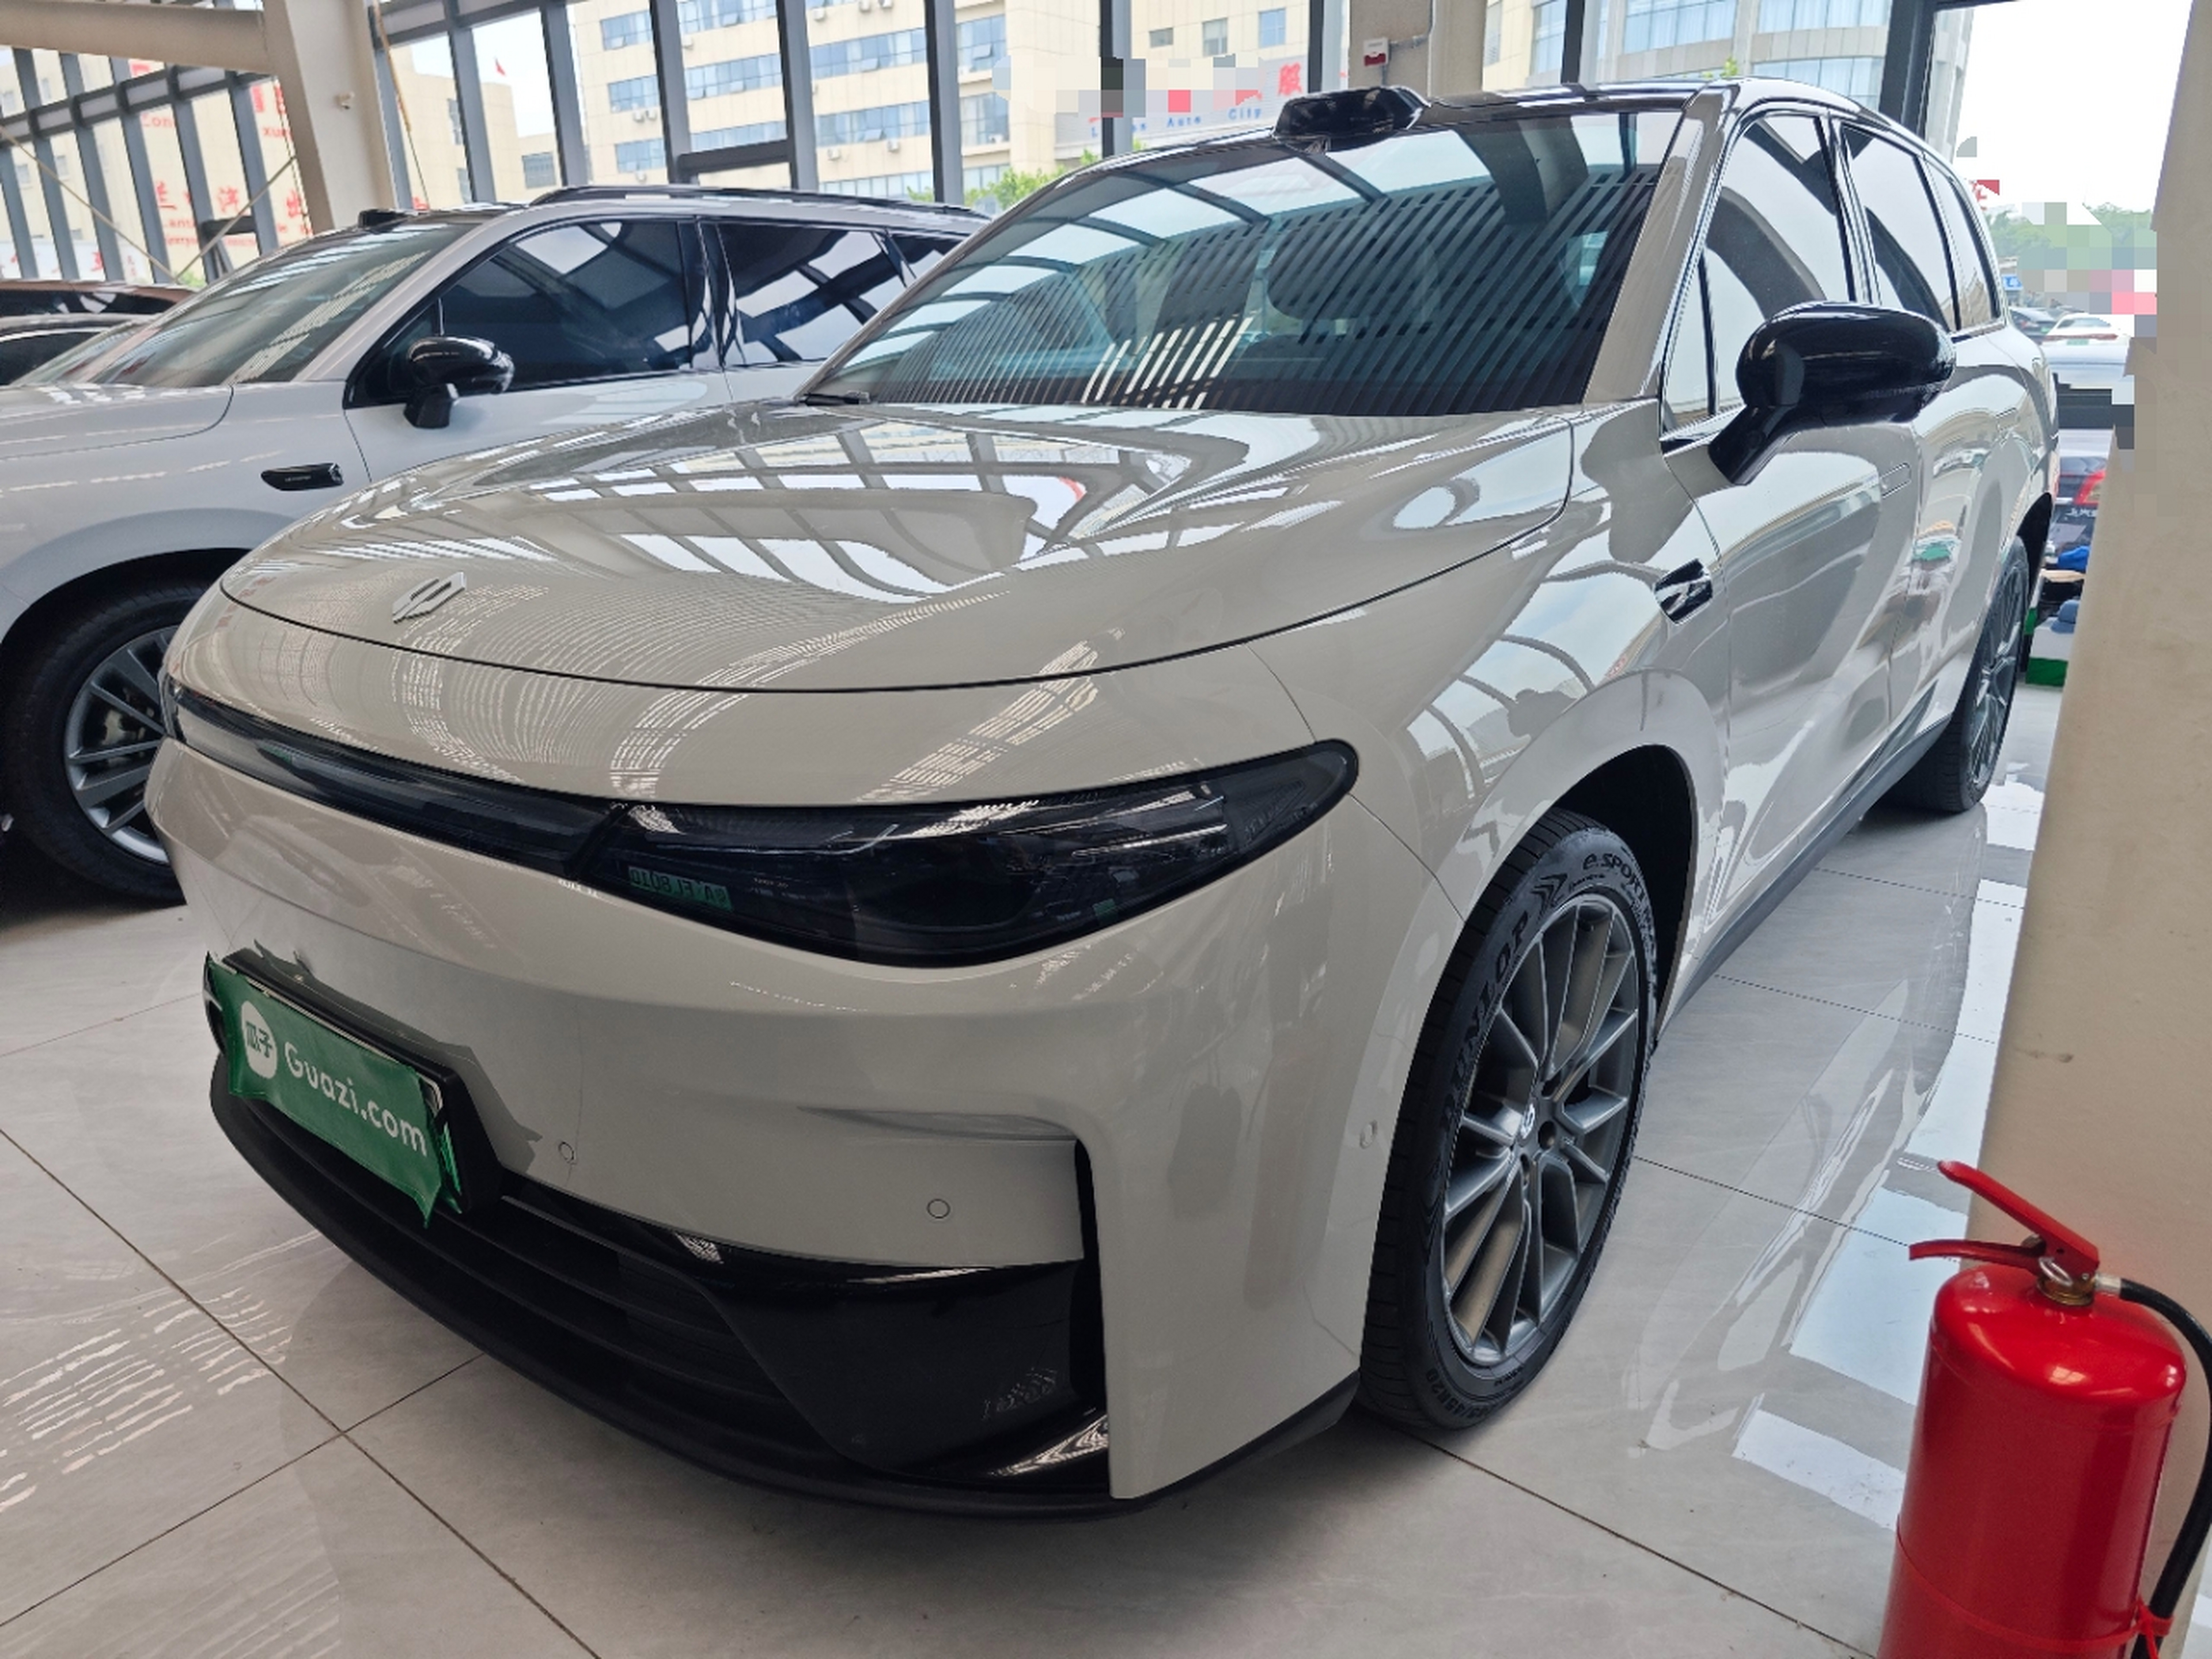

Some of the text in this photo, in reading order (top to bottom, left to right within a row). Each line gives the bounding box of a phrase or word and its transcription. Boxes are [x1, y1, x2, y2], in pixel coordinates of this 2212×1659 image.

[1167, 107, 1262, 128] Auto City
[1441, 910, 1528, 1132] DUNLOP
[285, 1041, 427, 1157] Guazi.com
